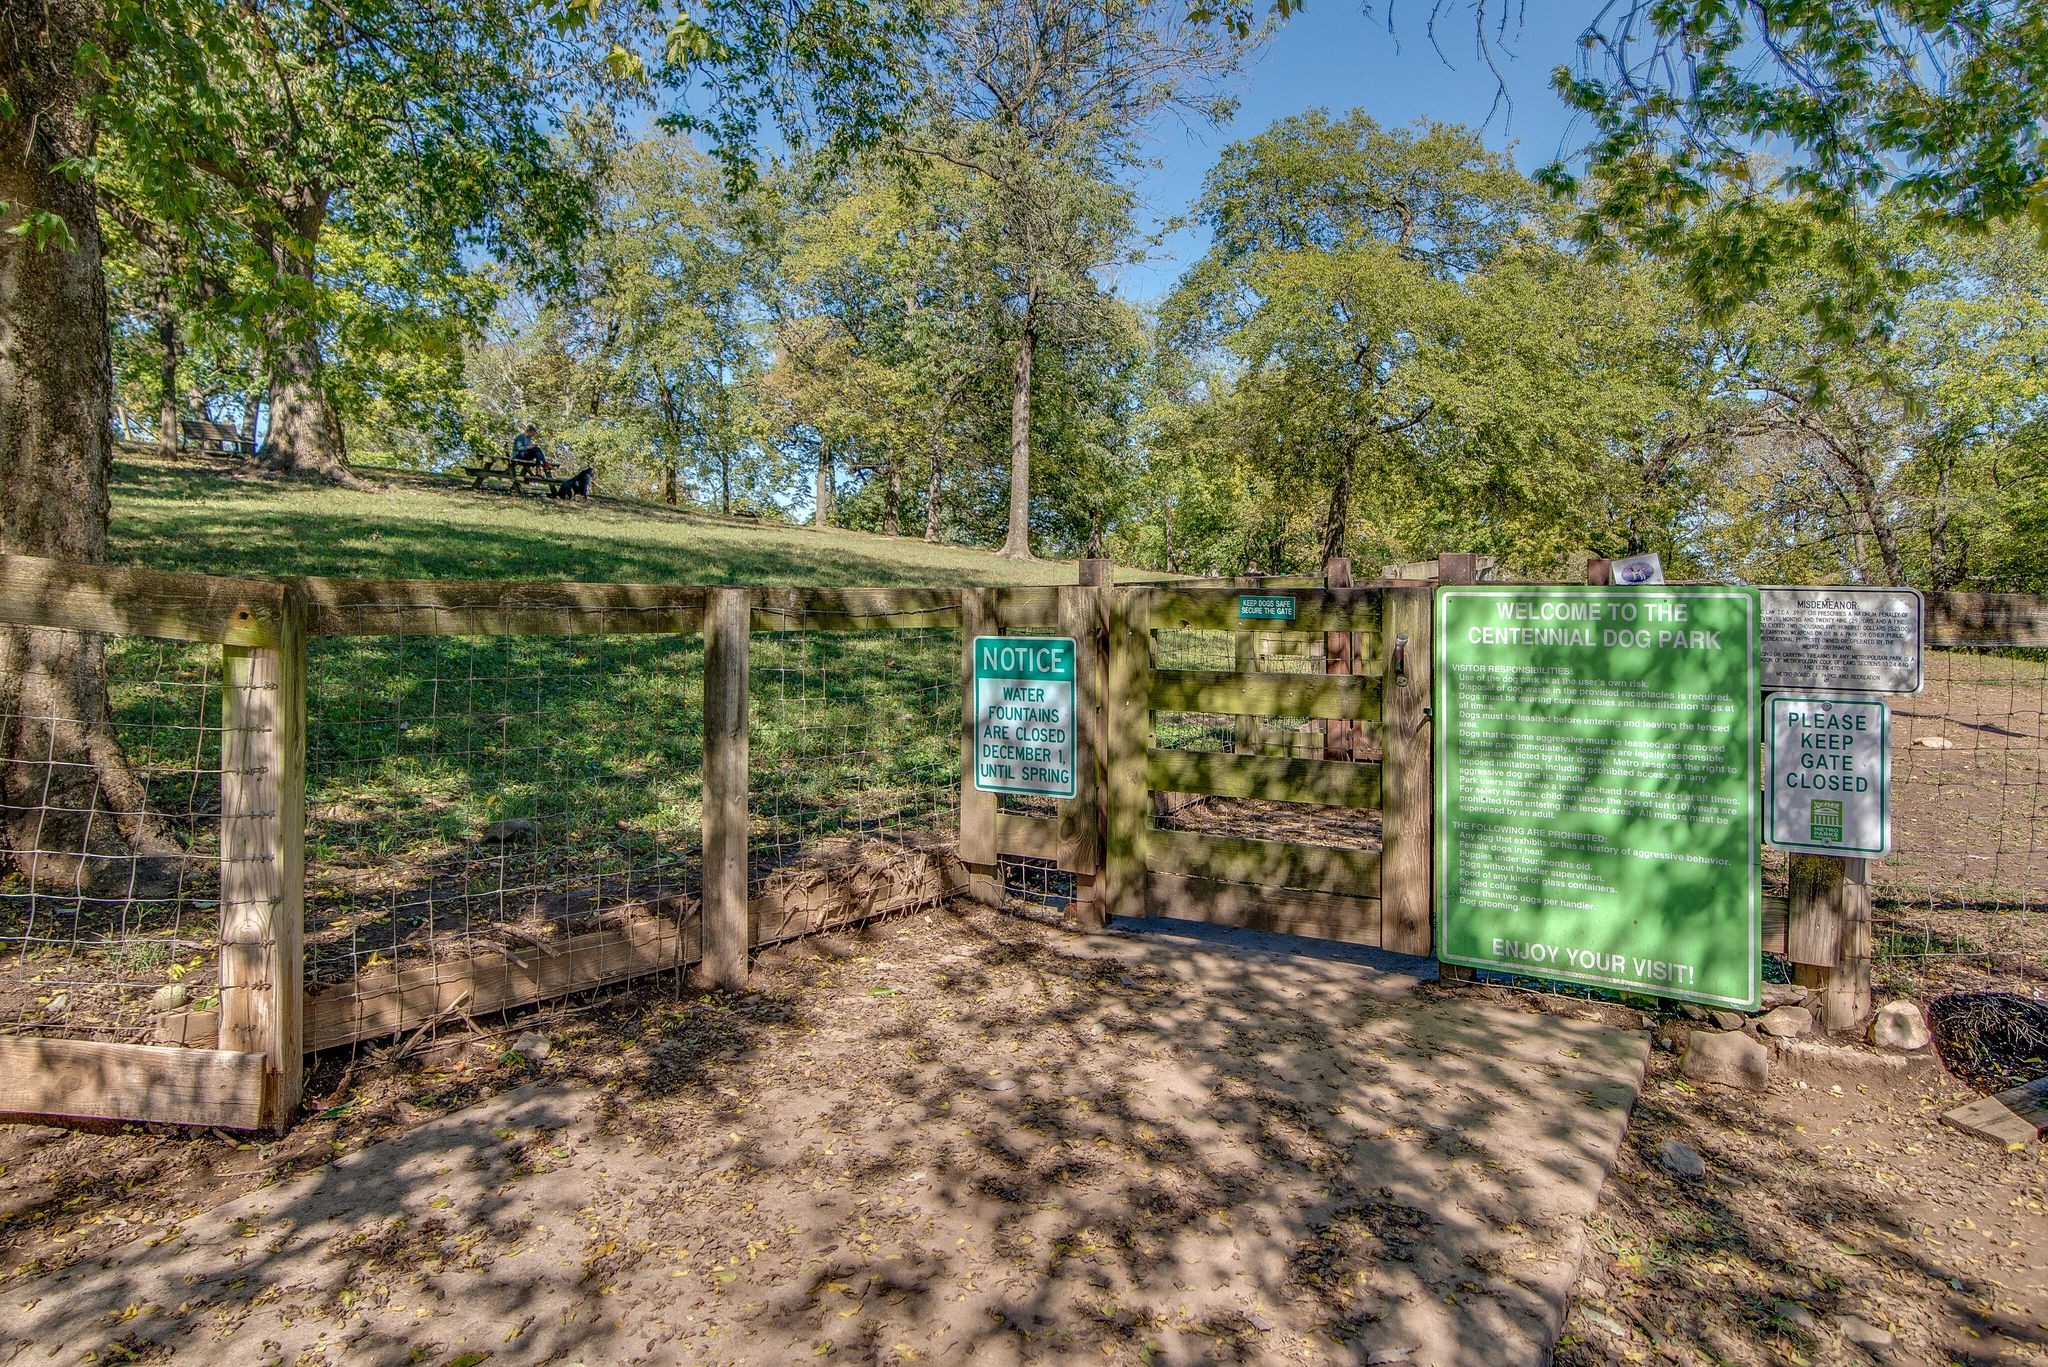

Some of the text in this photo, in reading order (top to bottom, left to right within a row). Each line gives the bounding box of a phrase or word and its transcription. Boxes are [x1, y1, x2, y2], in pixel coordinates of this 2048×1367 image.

[1496, 602, 1688, 622] WELCOME TO THE
[1468, 626, 1721, 650] CENTENNIAL DOG PARK
[983, 646, 1066, 673] NOTICE
[1488, 665, 1573, 674] RESPONSIBILITIES:
[1520, 676, 1539, 684] park
[1003, 686, 1044, 702] WATER
[1459, 692, 1480, 700] Dogs
[1518, 695, 1551, 704] wearing
[1637, 700, 1698, 710] identification
[1701, 704, 1722, 712] tags
[988, 706, 1060, 723] FOUNTAINS
[1459, 711, 1480, 719] Dogs
[1584, 718, 1620, 727] entering
[1643, 721, 1676, 730] leaving
[1697, 724, 1729, 732] fenced
[1788, 712, 1866, 730] PLEASE
[984, 726, 1066, 744] ARE CLOSED
[1801, 733, 1854, 750] KEEP
[983, 744, 1050, 762] DECEMBER
[1801, 753, 1853, 771] GATE
[980, 764, 1070, 784] UNTIL SPRING
[1459, 766, 1504, 777] aggressive
[1506, 770, 1522, 778] dog
[1556, 774, 1591, 782] handler.
[1787, 772, 1868, 792] CLOSED
[1584, 785, 1622, 794] on-hand
[1664, 792, 1682, 801] dog
[1710, 796, 1740, 804] times.
[1459, 803, 1504, 814] supervised
[1506, 808, 1517, 816] by
[1532, 810, 1555, 818] adult.
[1471, 822, 1524, 833] FOLLOWING
[1548, 830, 1607, 842] PROHIBITED:
[1459, 831, 1475, 840] Any
[1477, 833, 1493, 842] dog
[1514, 837, 1547, 846] exhibits
[1587, 844, 1618, 855] history
[1633, 849, 1684, 862] aggressive
[1686, 855, 1731, 865] behavior.
[1459, 840, 1488, 849] Female
[1490, 844, 1512, 853] dogs
[1524, 847, 1545, 856] heat.
[1459, 850, 1492, 860] Puppies
[1495, 854, 1519, 862] under
[1541, 859, 1573, 868] months
[1459, 858, 1604, 883] Dogs without handler supervision.
[1459, 868, 1480, 876] Food
[1493, 873, 1508, 881] any
[1542, 878, 1565, 888] glass
[1568, 881, 1617, 893] containers.
[1459, 878, 1520, 891] Spiked collars.
[1459, 887, 1480, 895] More
[1482, 890, 1500, 898] than
[1520, 894, 1541, 904] dogs
[1543, 898, 1558, 906] per
[1560, 899, 1596, 910] handler.
[1459, 896, 1520, 912] Dog grooming.
[1492, 937, 1693, 984] ENJOY YOUR VISIT!
